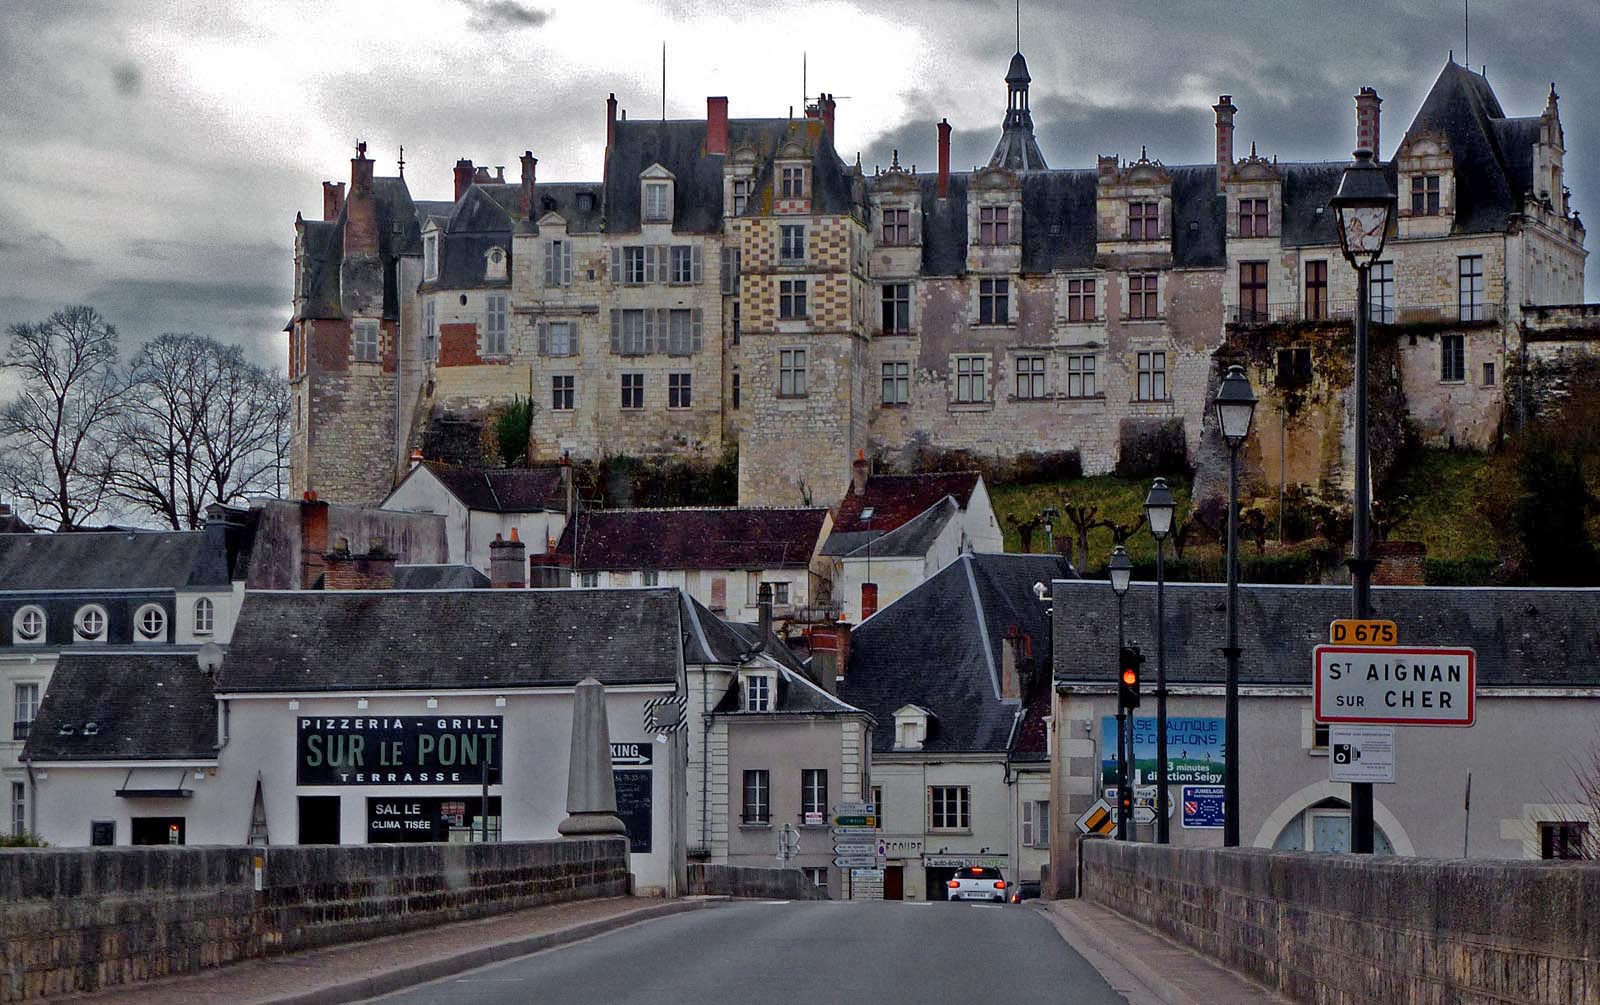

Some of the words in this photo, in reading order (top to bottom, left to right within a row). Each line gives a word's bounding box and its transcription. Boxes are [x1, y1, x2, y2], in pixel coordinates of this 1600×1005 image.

[1334, 624, 1347, 642] D
[1354, 624, 1394, 642] 675
[1366, 663, 1461, 682] AIGNAN
[1336, 695, 1365, 707] SUR
[1384, 690, 1453, 709] CHER
[302, 718, 403, 730] PIZZERIA
[437, 718, 499, 730] GRILL
[1166, 719, 1219, 732] AUTIQUE
[1147, 733, 1218, 745] CUFLONS
[306, 734, 365, 768] SUR
[380, 741, 404, 766] LE
[418, 733, 497, 767] PONT
[611, 743, 639, 758] KING
[1167, 762, 1175, 772] 3
[1176, 763, 1211, 773] minutes
[340, 772, 461, 782] TERRASSE
[1147, 771, 1193, 782] diction
[1194, 771, 1223, 784] Seigy
